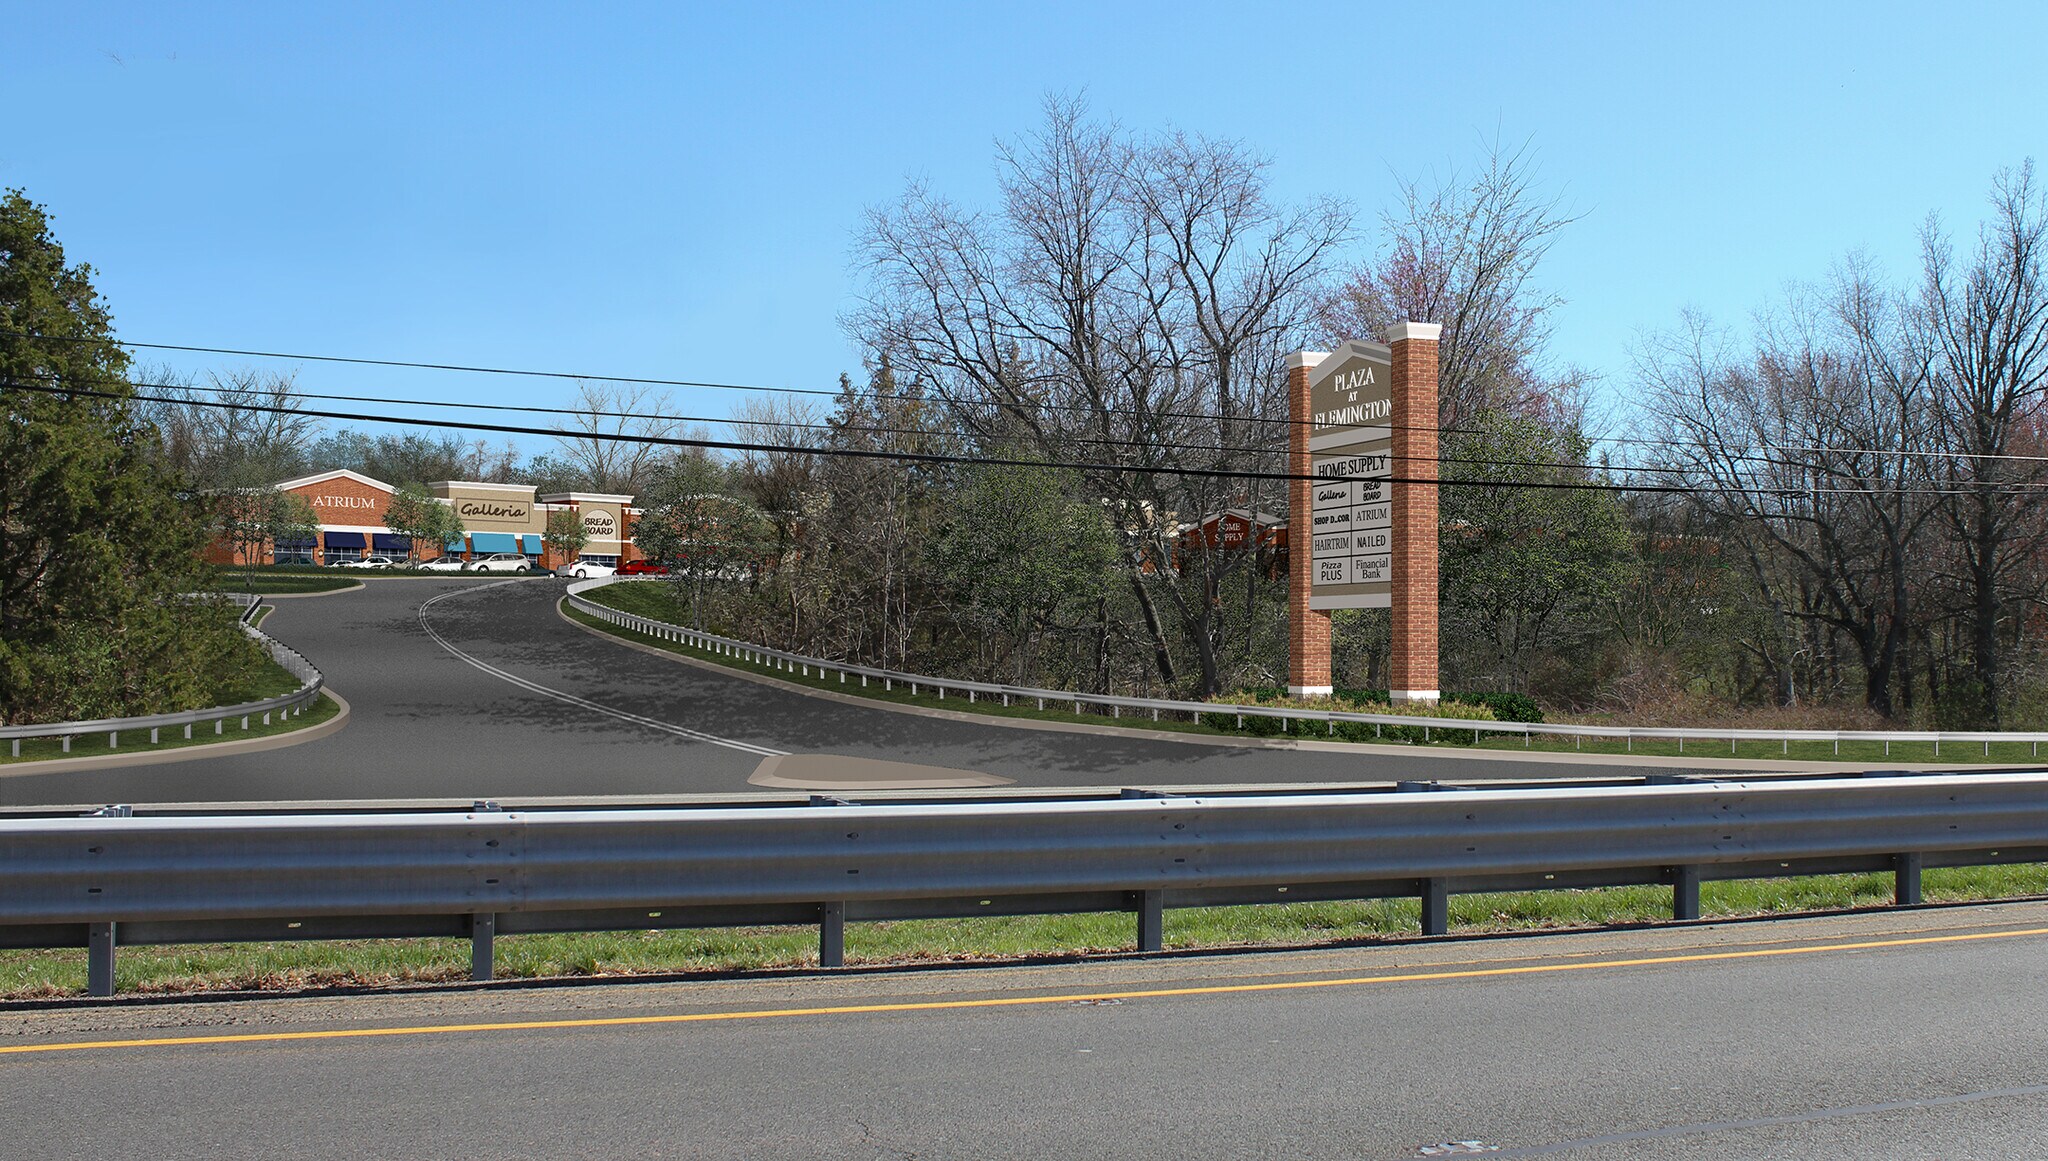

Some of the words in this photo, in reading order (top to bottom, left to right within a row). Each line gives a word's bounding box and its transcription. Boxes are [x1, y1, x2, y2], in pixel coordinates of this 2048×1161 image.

[1334, 367, 1375, 392] PLAZA
[1348, 391, 1358, 402] AT
[1318, 461, 1347, 477] HOME
[1348, 454, 1386, 474] SUPPLY
[1363, 491, 1381, 501] BOARD
[313, 496, 375, 509] ATRIUM
[460, 503, 526, 517] Galleria
[1356, 508, 1387, 521] ATRIUM
[584, 517, 613, 526] BREAD
[1314, 516, 1329, 525] SHOP
[1219, 522, 1240, 531] OME
[1214, 532, 1244, 541] SPPLY
[1357, 535, 1386, 548] NAILED
[1314, 537, 1349, 551] HAIRTRIM
[1356, 557, 1388, 569] Financial
[1321, 570, 1342, 581] PLUS
[1362, 568, 1381, 579] Bank
